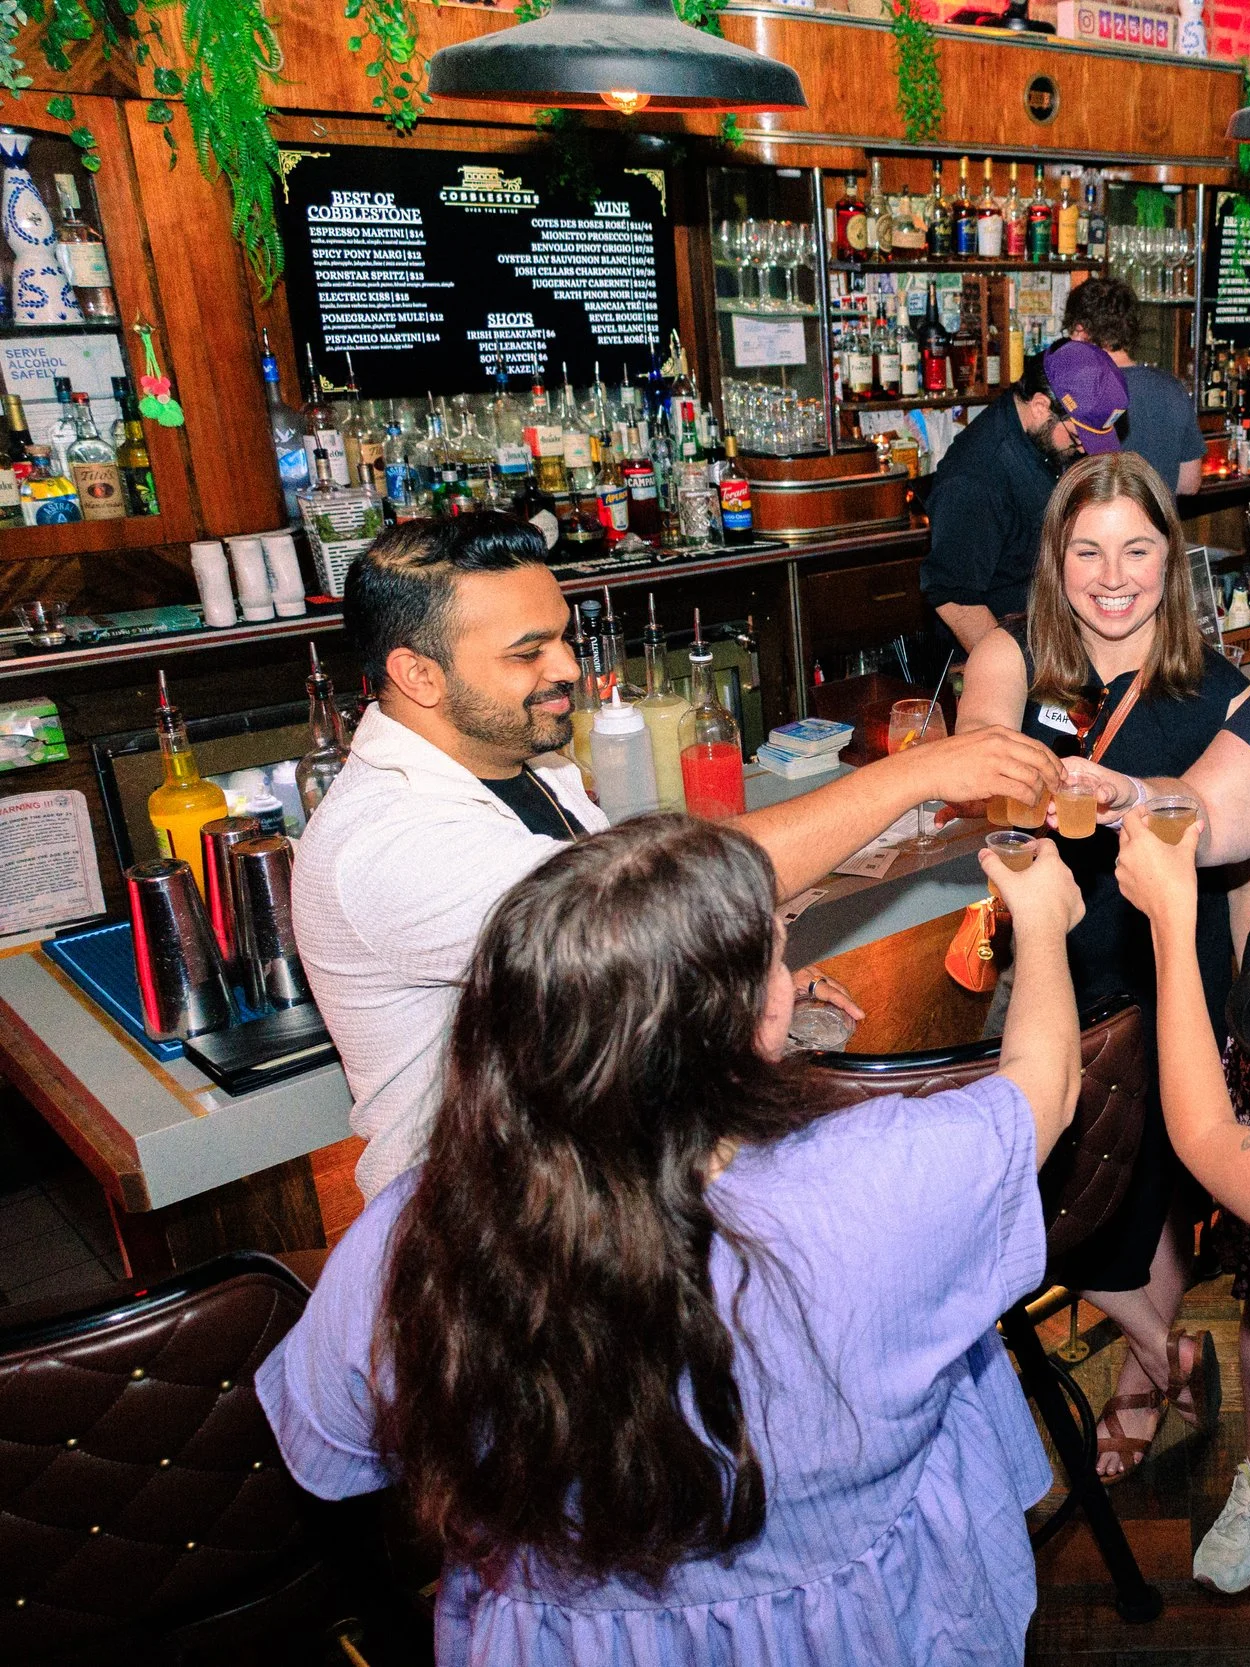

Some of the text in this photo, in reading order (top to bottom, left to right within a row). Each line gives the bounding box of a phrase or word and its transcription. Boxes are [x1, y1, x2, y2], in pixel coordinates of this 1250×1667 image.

[331, 190, 396, 208] BEST OF
[439, 191, 540, 204] COBBLESTONE
[594, 201, 630, 215] WINE
[307, 205, 423, 223] COBBLESTONE
[531, 218, 559, 228] COTES
[560, 219, 577, 228] DES
[578, 220, 604, 229] ROSES
[605, 218, 627, 229] ROSÉ
[309, 227, 424, 239] ESPRESSO MARTINI $14
[541, 231, 587, 241] MIONETTO
[587, 232, 630, 242] PROSECCO
[531, 243, 575, 252] BENVOLIO
[575, 243, 602, 253] PINOT
[602, 244, 631, 253] GRIGIO
[312, 249, 422, 260] SPICY PONY MARG $12
[497, 255, 532, 264] OYSTER
[532, 255, 550, 264] BAY
[550, 255, 600, 265] SAUVIGNON
[601, 255, 628, 265] BLANC
[315, 271, 370, 280] PORNSTAR
[371, 271, 405, 280] SPRITZ
[515, 267, 537, 277] JOSH
[538, 267, 575, 276] CELLARS
[575, 267, 632, 277] CHARDONNAY
[532, 279, 588, 289] JUGGERNAUT
[588, 279, 630, 288] CABERNET
[318, 292, 367, 302] ELECTRIC
[368, 292, 391, 301] KISS
[554, 291, 582, 299] ERATH
[610, 291, 631, 299] NOIR
[584, 302, 625, 311] BRANCAIA
[626, 300, 641, 311] TRÉ
[321, 312, 444, 323] POMEGRANATE MULE $12
[487, 312, 534, 327] SHOTS
[589, 314, 615, 322] REVEL
[615, 314, 643, 322] ROUGE
[591, 324, 617, 333] REVEL
[617, 325, 644, 333] BLANC
[324, 333, 440, 344] PISTACHIO MARTINI $14
[466, 329, 556, 340] IRISH BREAKFAST $6
[598, 336, 623, 344] REVEL
[624, 334, 644, 344] ROSÉ
[537, 342, 547, 350] $6
[5, 347, 46, 359] SERVE
[505, 353, 534, 363] PATCH
[538, 353, 548, 361] $6
[8, 357, 67, 370] ALCOHOL
[11, 367, 58, 380] SAFELY
[1045, 708, 1069, 724] LEAH
